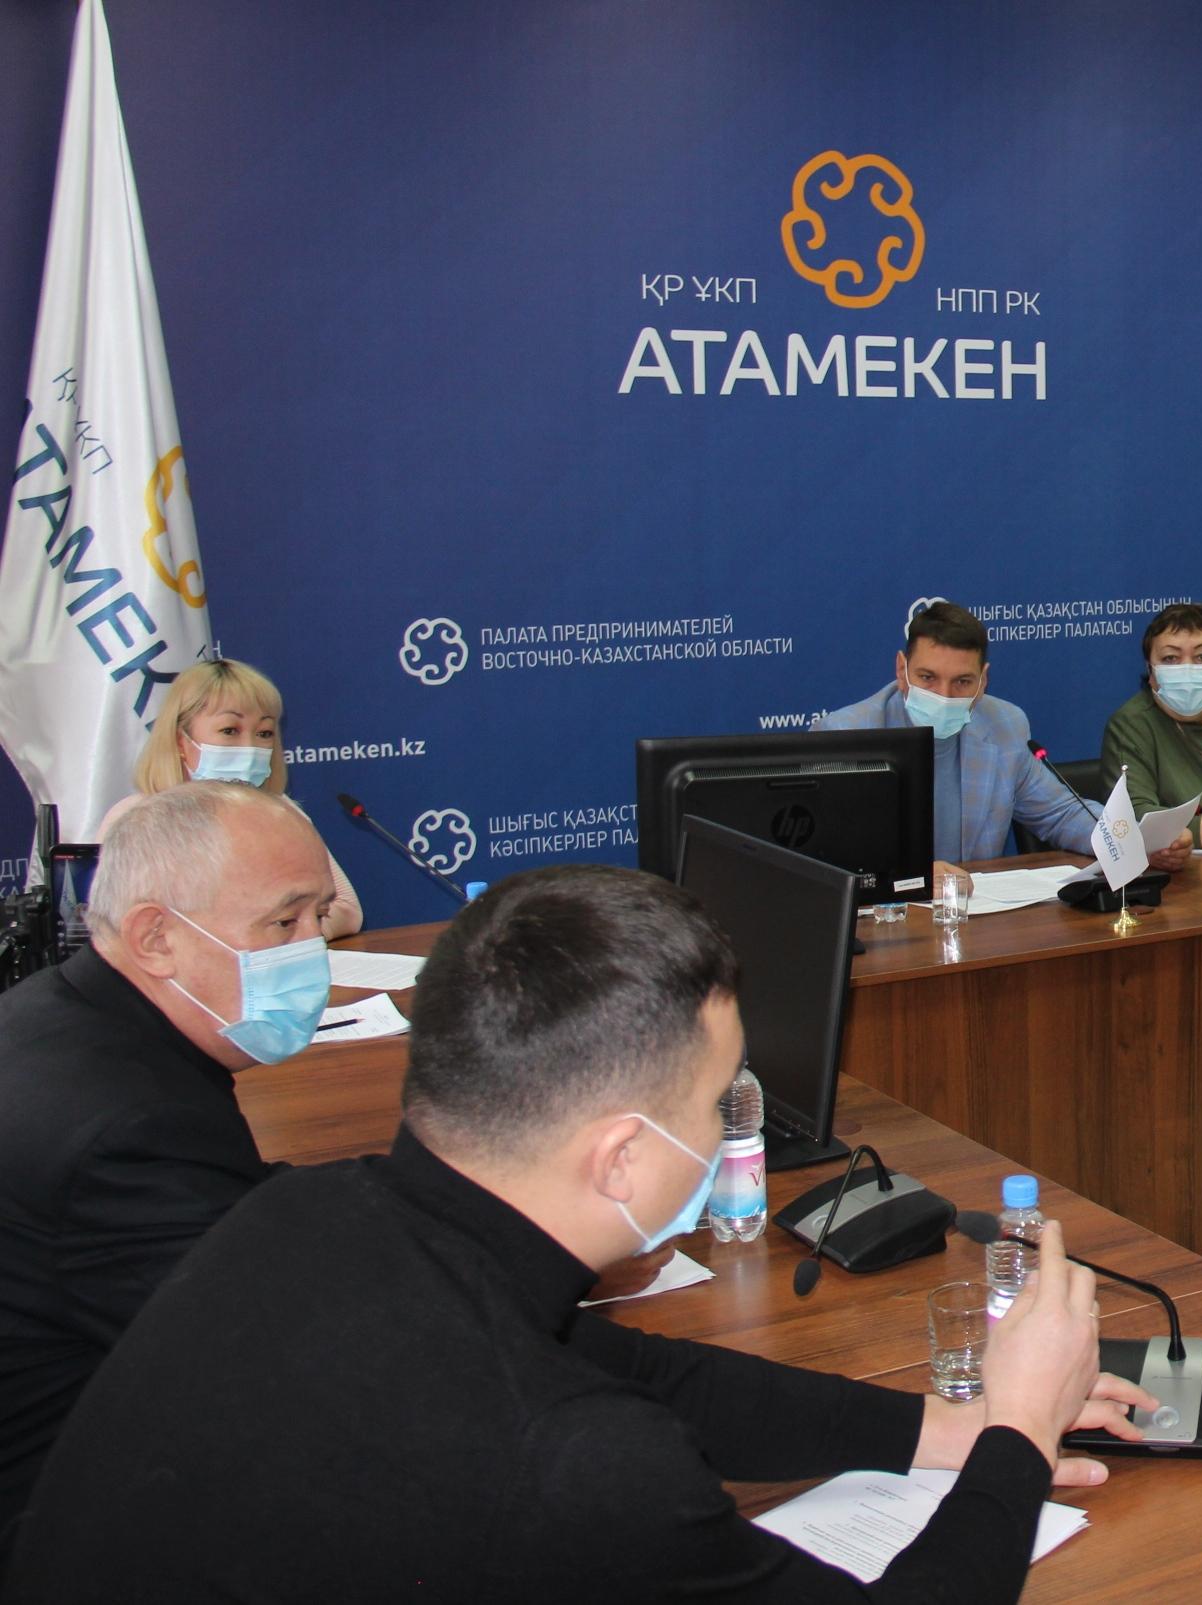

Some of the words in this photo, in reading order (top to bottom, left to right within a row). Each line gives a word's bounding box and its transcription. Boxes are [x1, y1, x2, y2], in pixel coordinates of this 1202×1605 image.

[641, 273, 685, 307] ҚР
[691, 275, 757, 304] ҰКП
[936, 286, 998, 314] НПП
[1005, 290, 1041, 316] РК
[617, 326, 1048, 401] АТАМЕКЕН
[13, 397, 184, 733] ТАМЕК
[1027, 600, 1104, 622] ҚАЗАҚСТАН
[481, 626, 548, 646] ПАЛАТА
[551, 614, 734, 644] ПРЕДПРИНИМАТЕЛЕЙ
[1065, 619, 1134, 639] ПАЛАТАСЫ
[481, 639, 717, 671] ВОСТОЧНО-КАЗАХСТАНСКОЙ
[720, 637, 794, 658] ОБЛАСТИ
[488, 811, 559, 834] ШЫҒЫС
[489, 831, 608, 858] КӘСІПКЕРЛЕР
